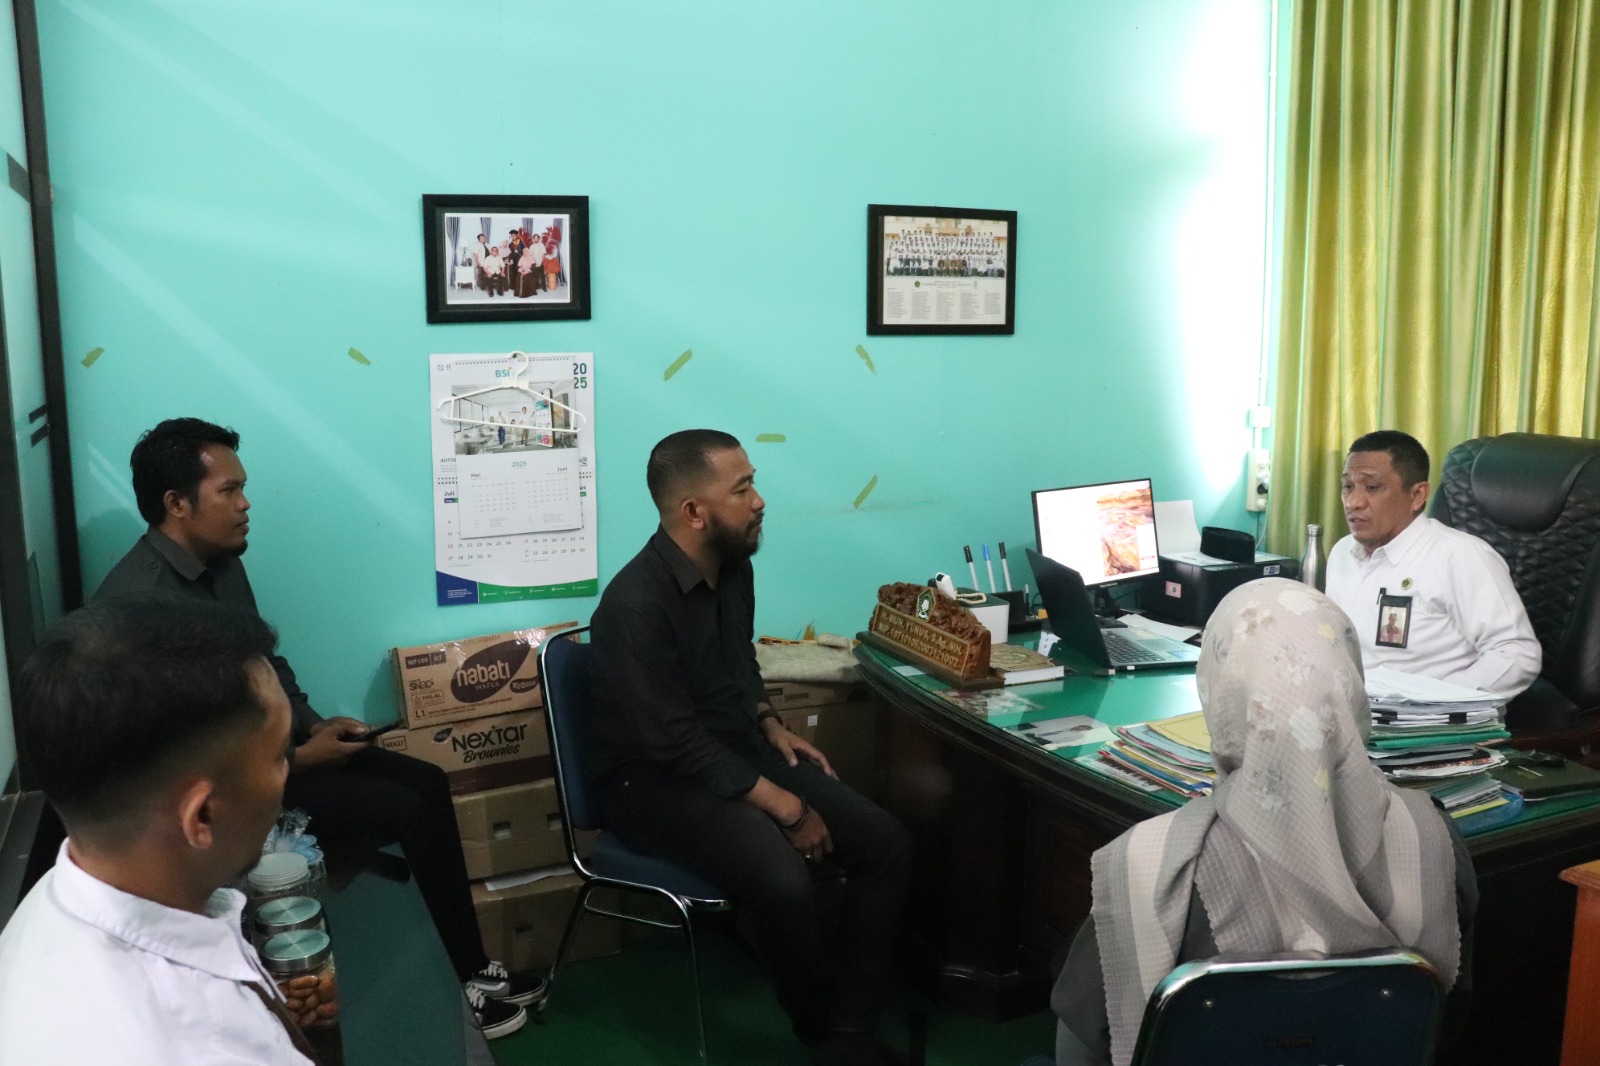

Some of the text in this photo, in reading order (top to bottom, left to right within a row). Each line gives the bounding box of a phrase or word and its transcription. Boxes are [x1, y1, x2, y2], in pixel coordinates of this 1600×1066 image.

[495, 369, 510, 378] BSI
[456, 660, 510, 686] nabati
[475, 682, 500, 690] WAFER
[416, 710, 425, 718] L1
[464, 744, 520, 764] Brownies
